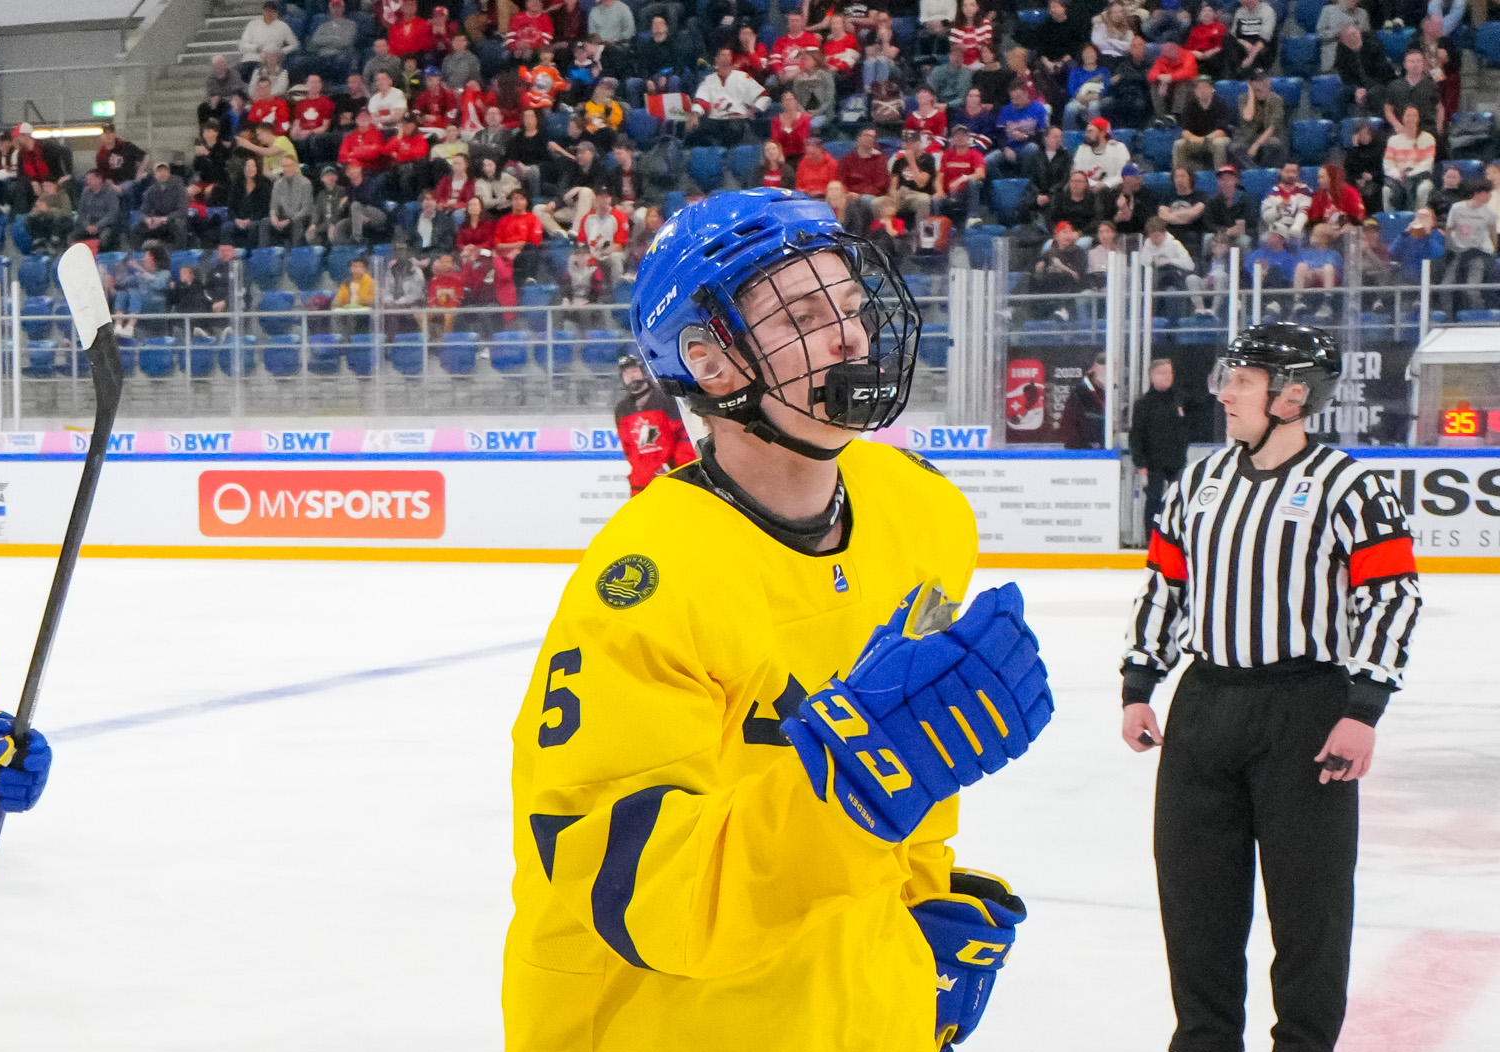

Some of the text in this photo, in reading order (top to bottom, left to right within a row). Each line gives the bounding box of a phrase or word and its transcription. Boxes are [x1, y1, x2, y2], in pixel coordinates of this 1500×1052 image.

[646, 284, 678, 329] CCM
[718, 394, 748, 409] CCM
[1444, 412, 1476, 434] 35
[184, 433, 231, 451] BWT
[282, 432, 331, 451] BWT
[486, 431, 537, 450] BWT
[930, 428, 987, 448] BWT
[259, 489, 431, 519] MYSPORTS
[538, 646, 582, 748] 5
[847, 792, 875, 830] SWEDEN
